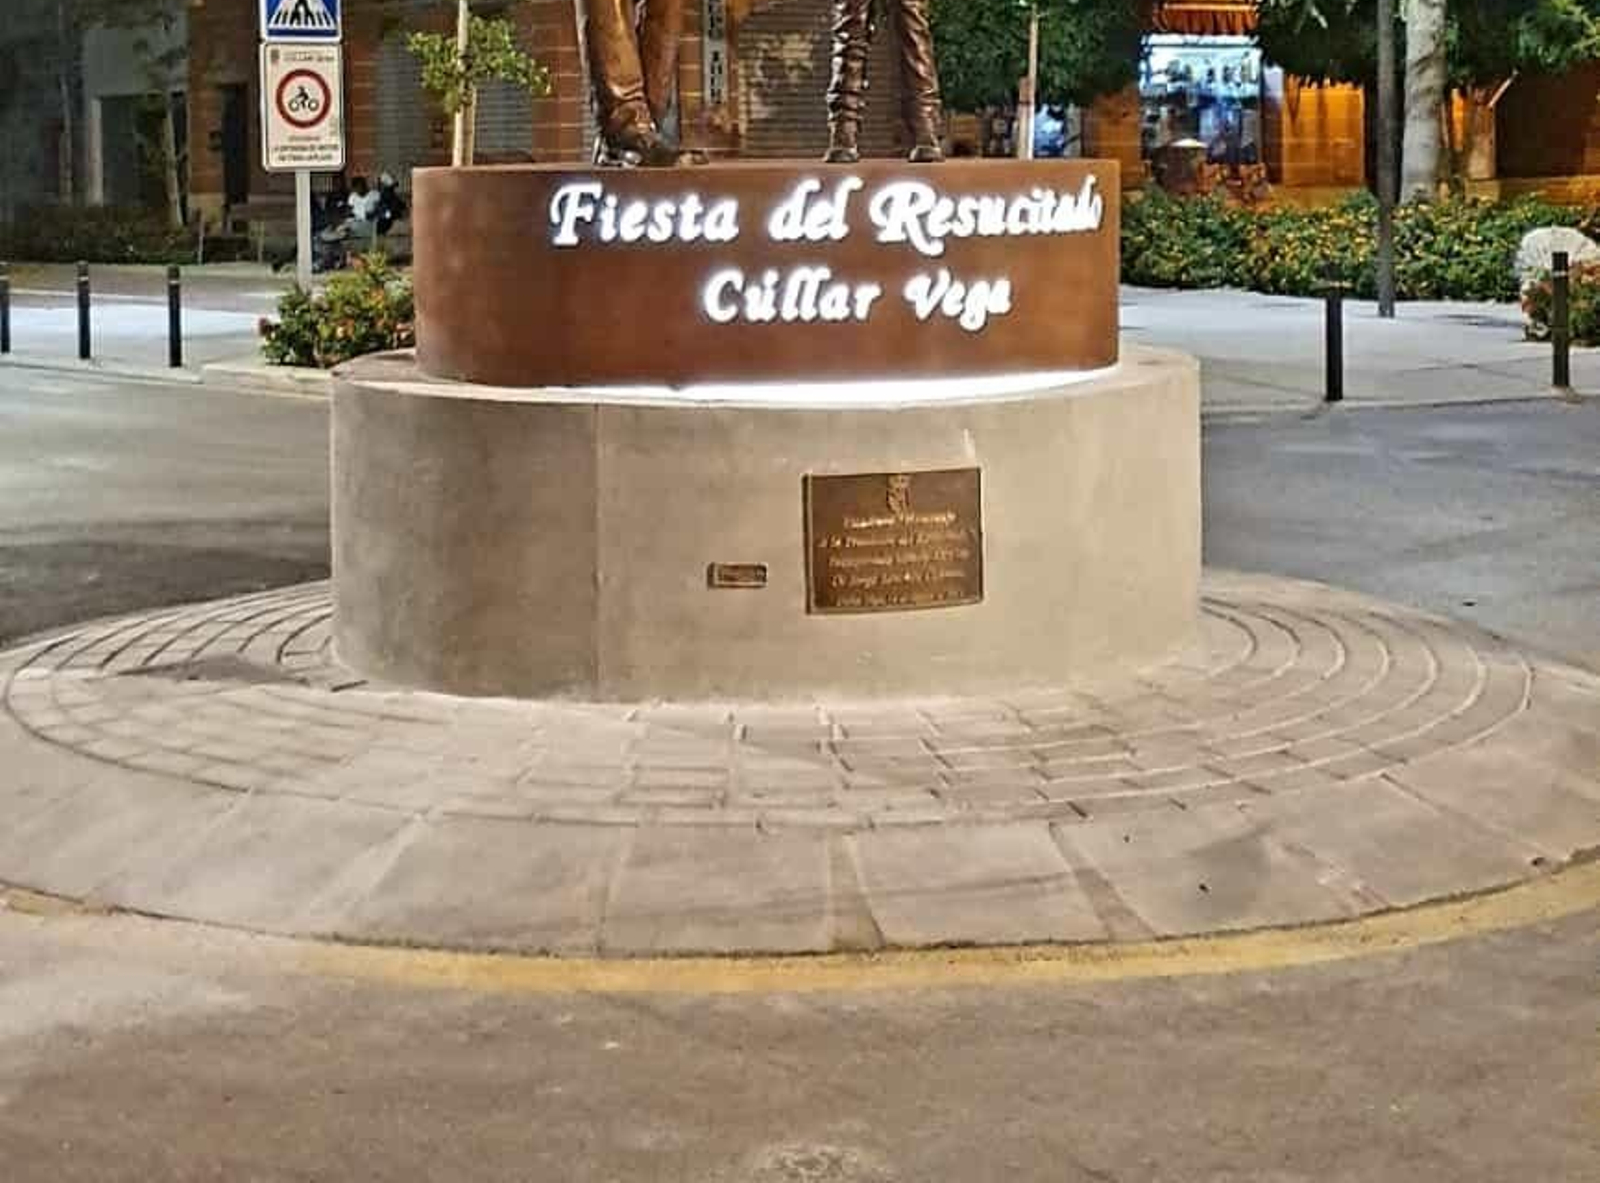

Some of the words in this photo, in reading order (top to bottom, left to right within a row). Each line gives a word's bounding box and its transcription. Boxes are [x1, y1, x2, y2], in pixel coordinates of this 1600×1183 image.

[550, 181, 740, 246] Fiesta
[767, 175, 865, 242] del
[903, 268, 1012, 332] Vega
